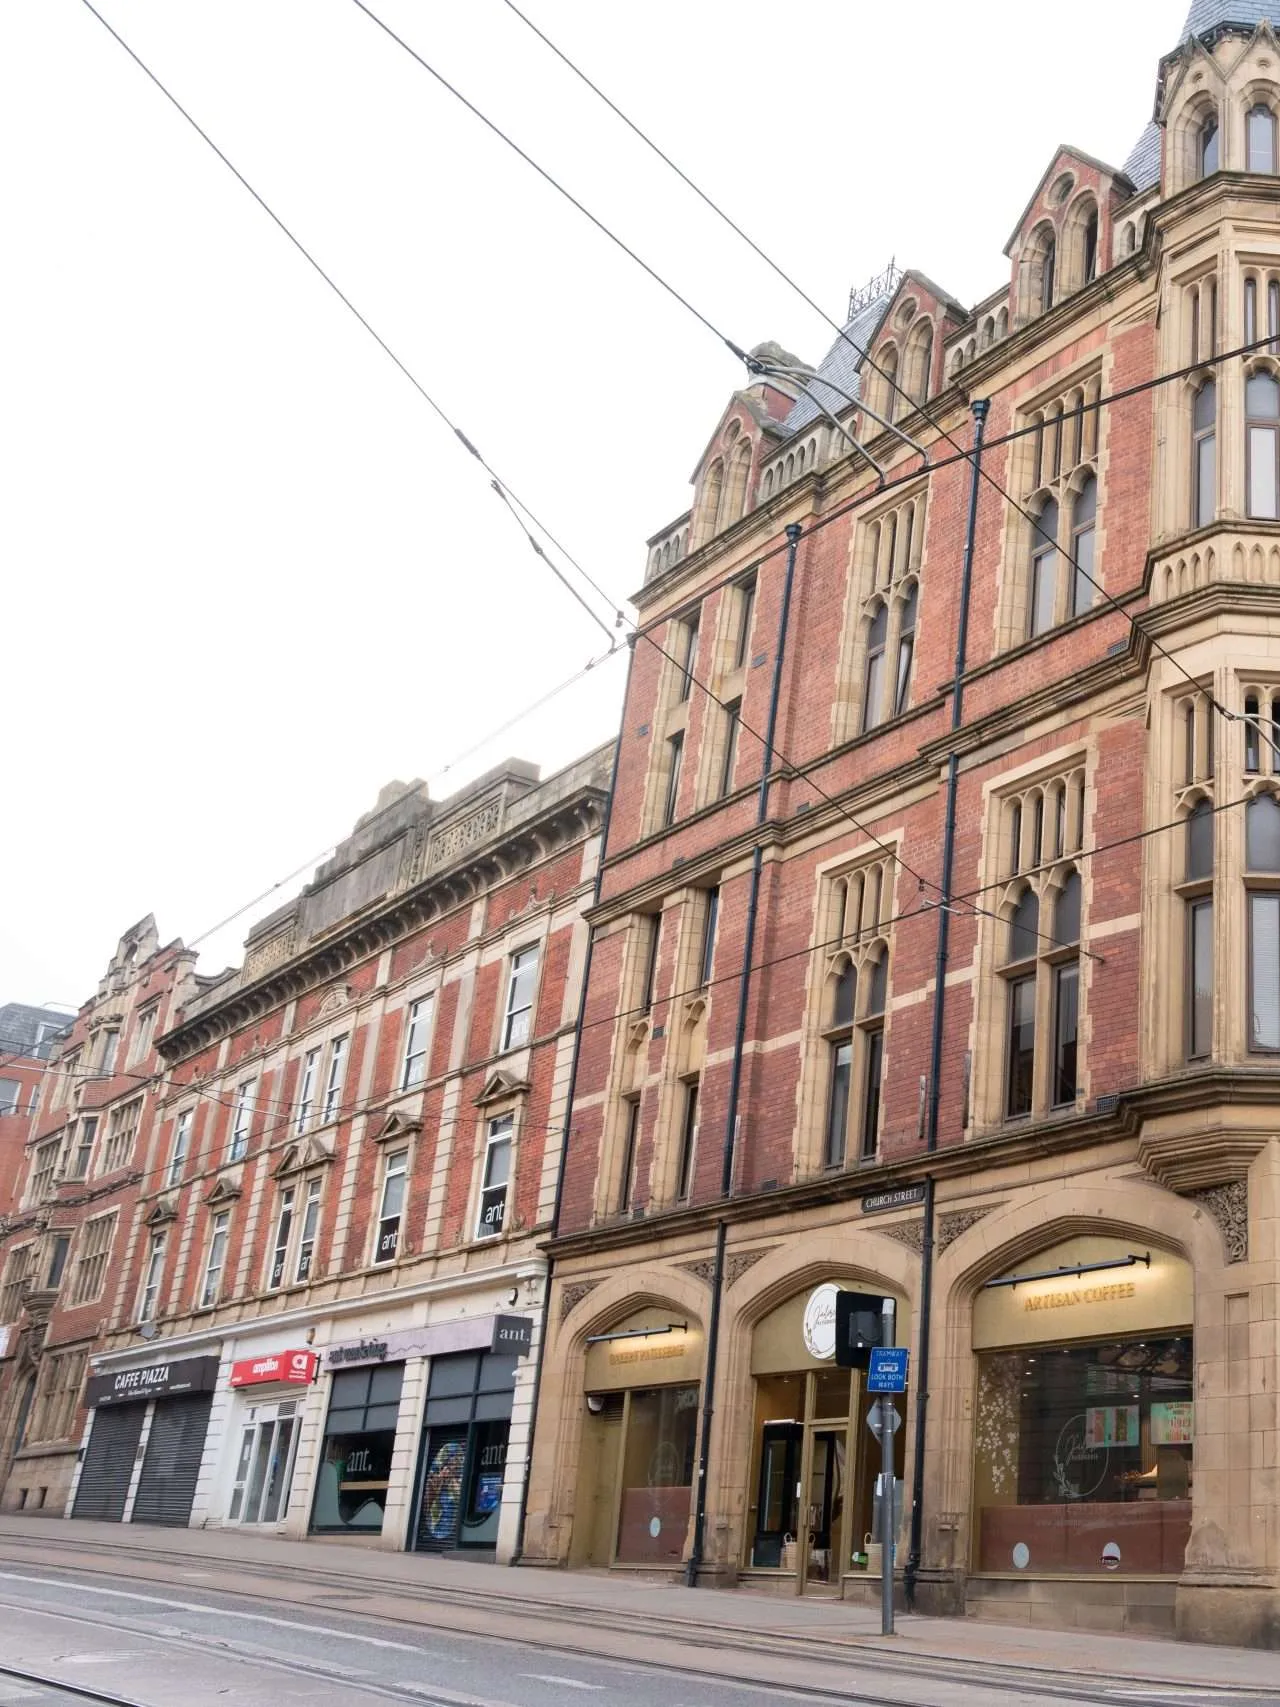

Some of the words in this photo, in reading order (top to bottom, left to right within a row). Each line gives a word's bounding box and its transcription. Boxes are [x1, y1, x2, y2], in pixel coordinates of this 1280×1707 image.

[865, 1194, 892, 1208] CHURCH
[893, 1188, 917, 1202] STREET
[1023, 1291, 1080, 1312] ARTISAN
[1083, 1282, 1135, 1304] COFFEE
[499, 1327, 531, 1342] ant.
[114, 1371, 139, 1390] CAFFE
[140, 1366, 169, 1385] PIAZZA
[346, 1448, 372, 1473] ant.
